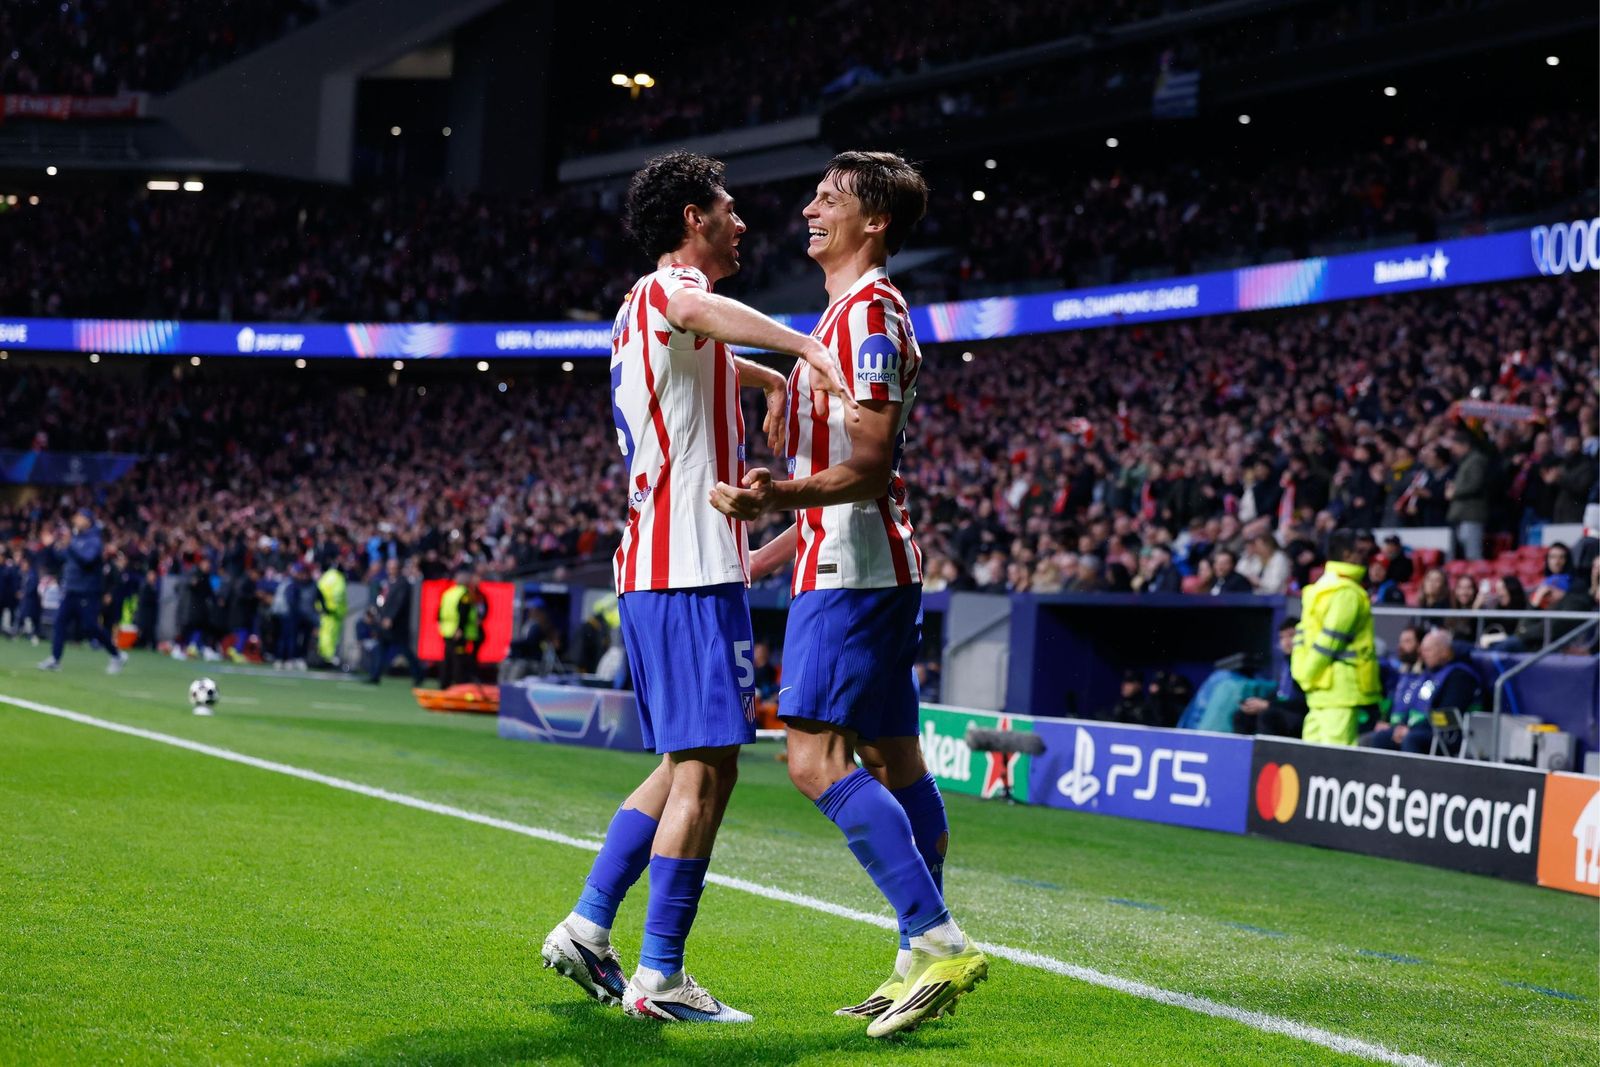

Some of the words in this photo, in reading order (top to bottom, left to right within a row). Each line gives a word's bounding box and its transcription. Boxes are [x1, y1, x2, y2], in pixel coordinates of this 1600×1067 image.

[857, 371, 896, 382] kraken
[734, 640, 754, 688] 5
[920, 720, 971, 782] ken
[1106, 743, 1208, 807] PS5
[1305, 774, 1537, 854] mastercard
